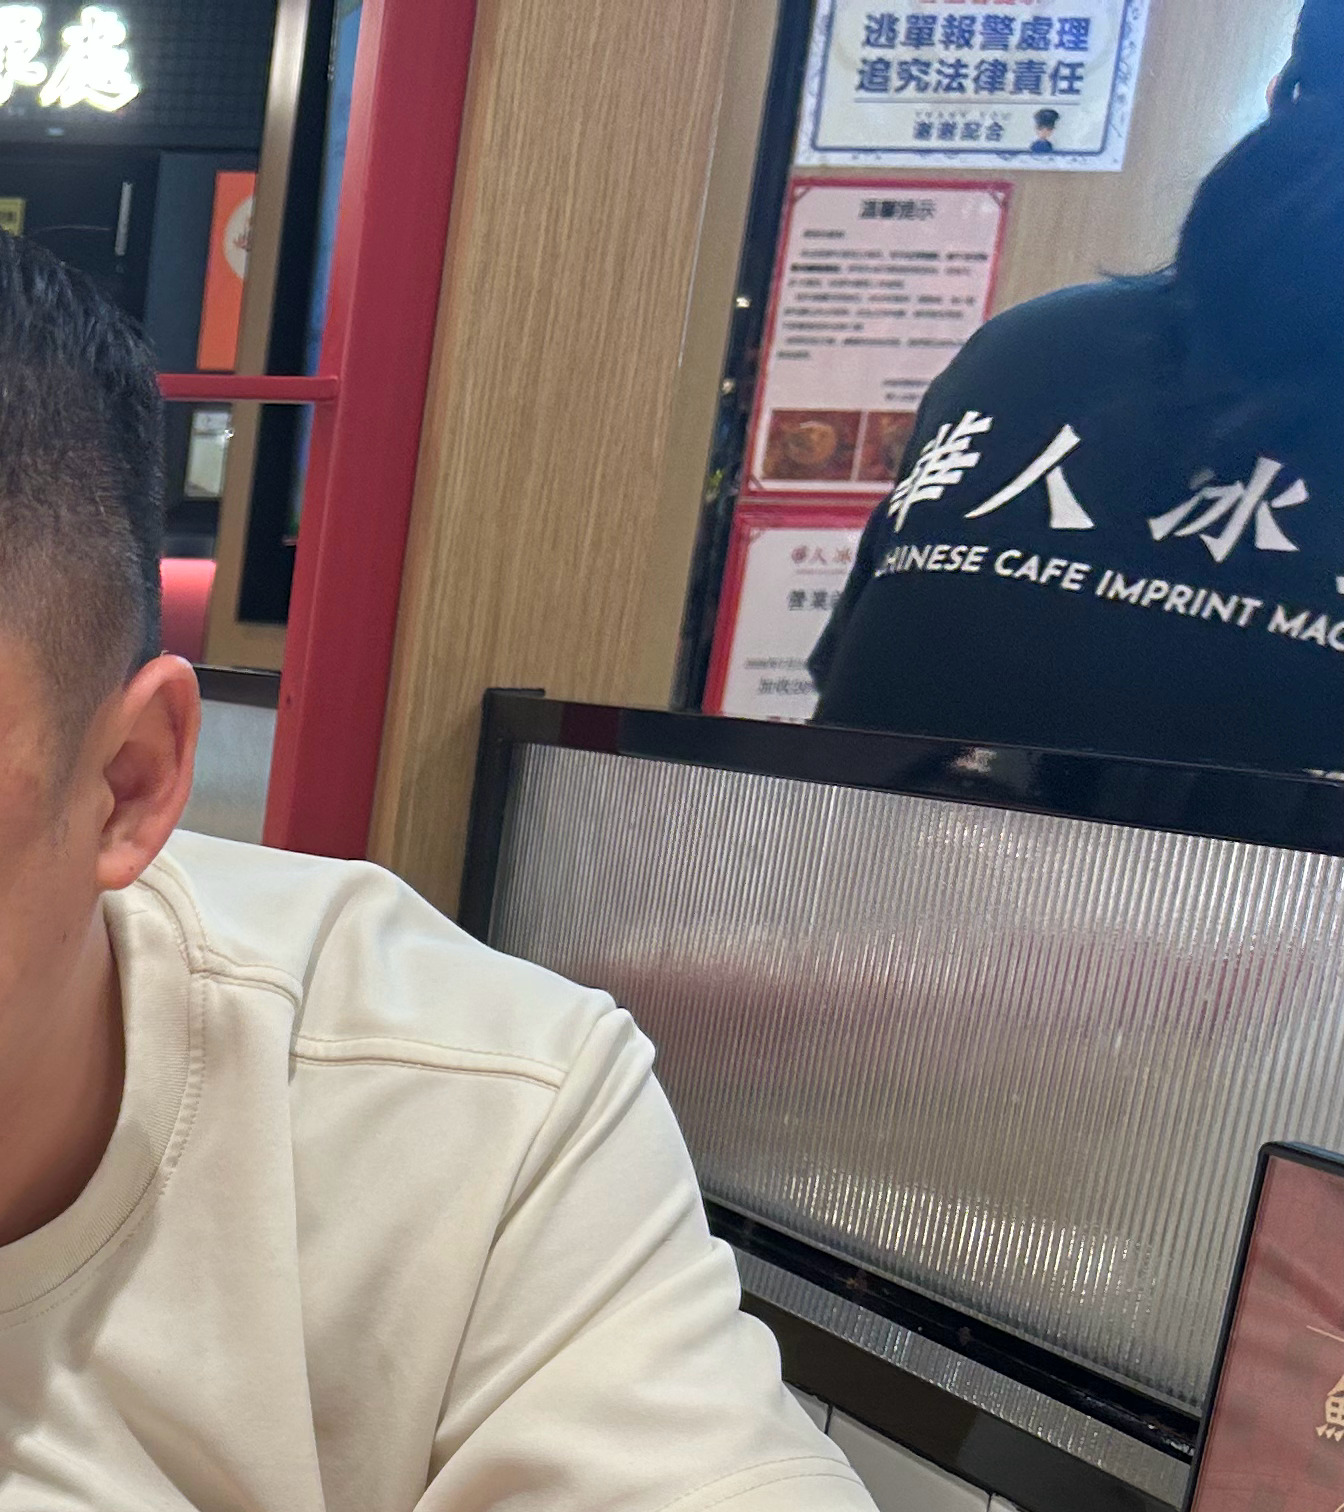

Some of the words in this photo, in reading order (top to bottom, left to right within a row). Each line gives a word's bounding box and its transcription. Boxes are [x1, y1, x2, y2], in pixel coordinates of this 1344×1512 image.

[862, 13, 1092, 52] 逃單報警處理
[855, 58, 1086, 97] 追究法律責任
[913, 121, 1006, 142] 謝謝配合
[888, 411, 1309, 562] 華人冰
[994, 550, 1092, 592] CAFE
[1095, 570, 1264, 628] IMPRINT
